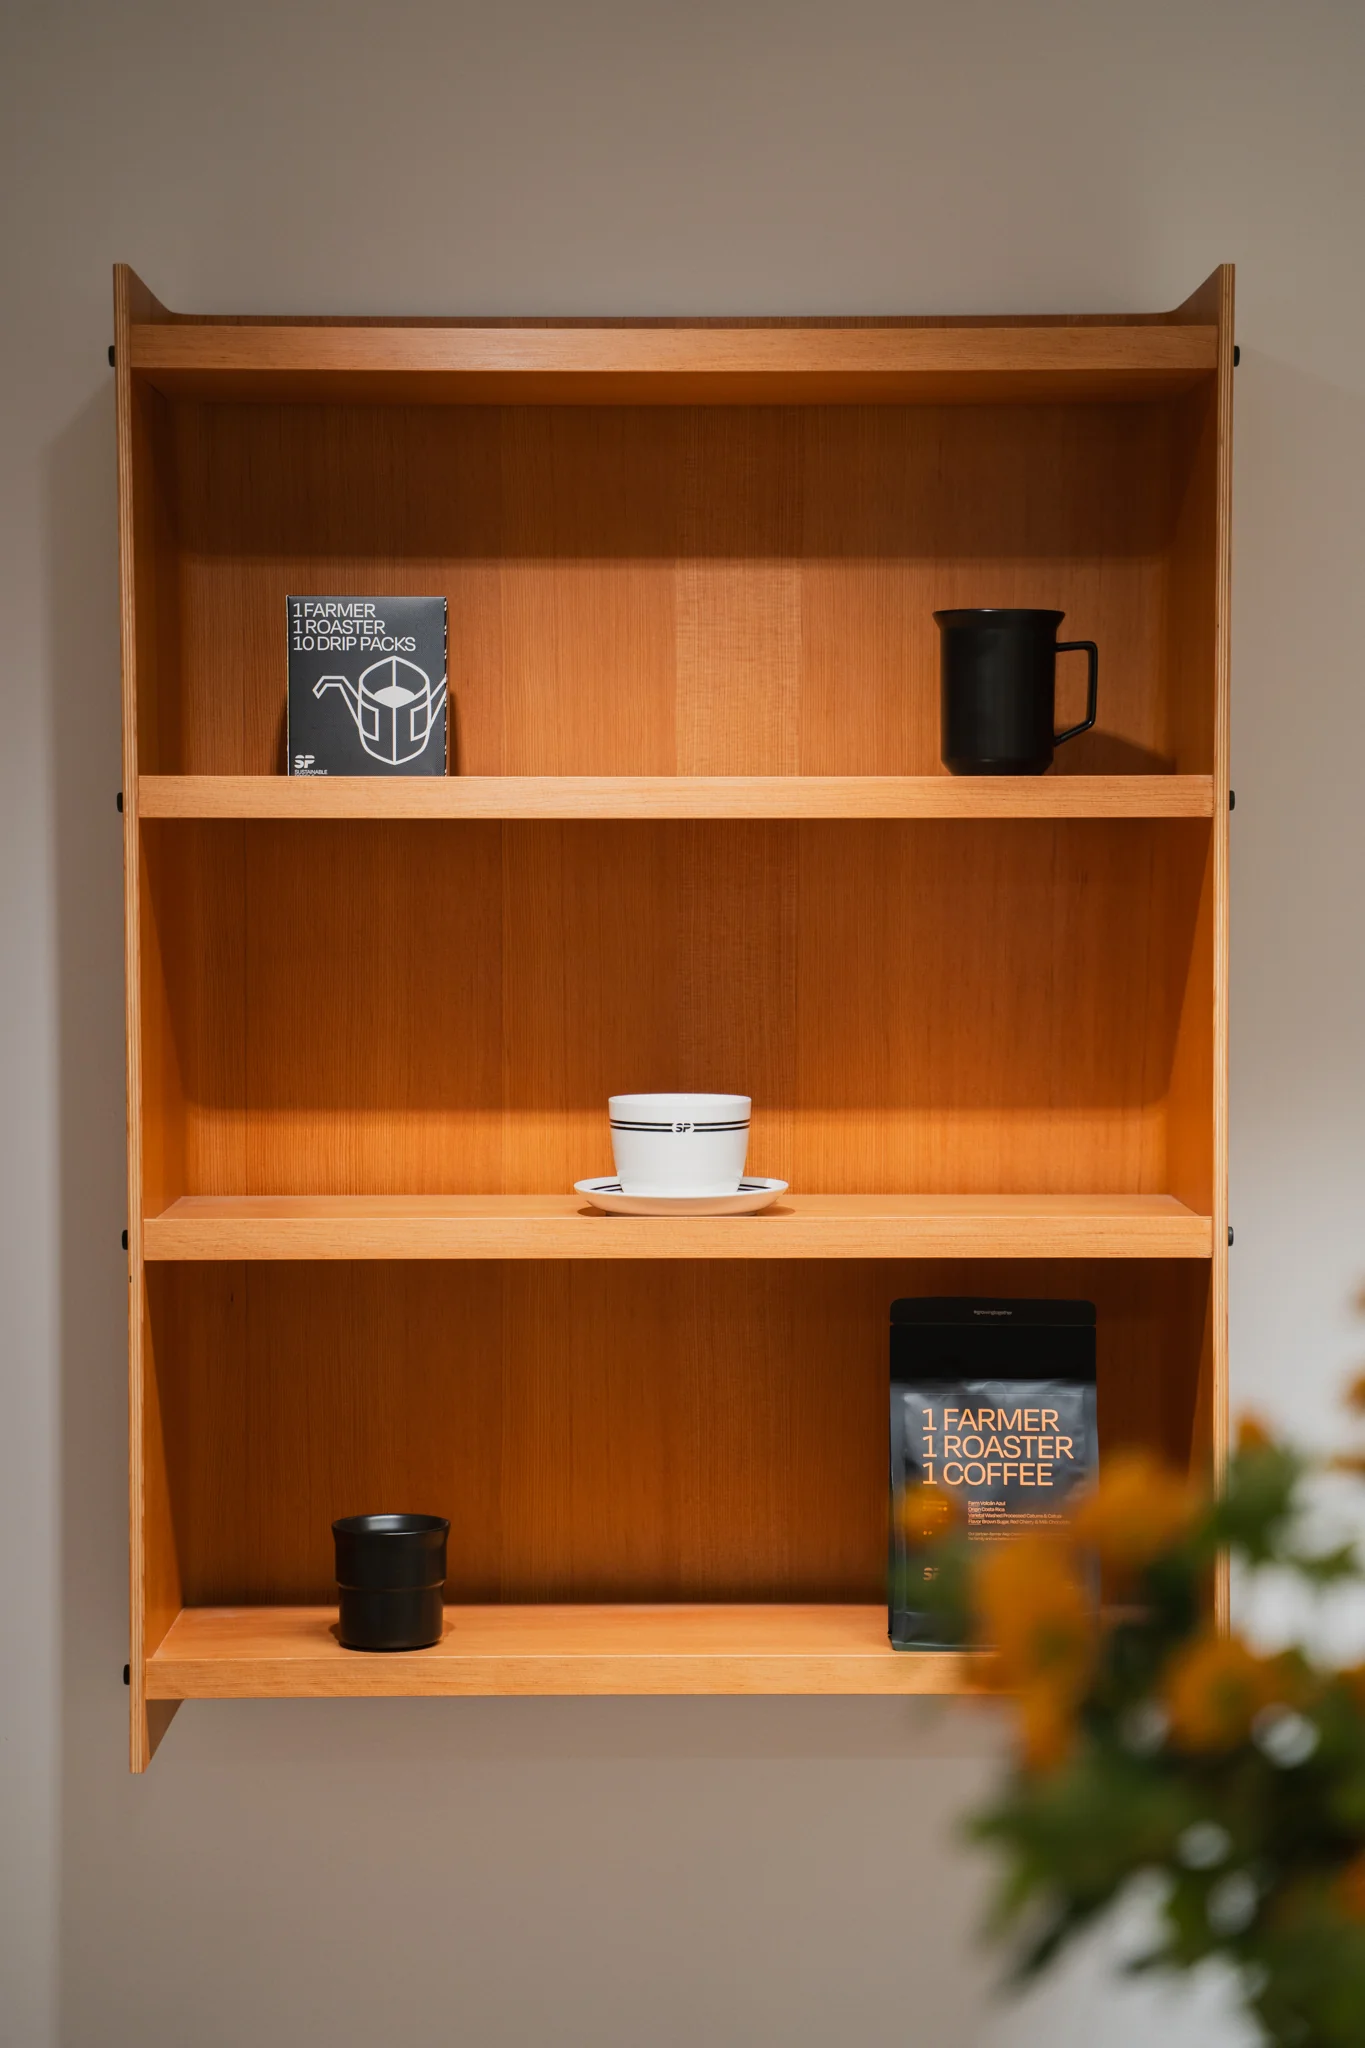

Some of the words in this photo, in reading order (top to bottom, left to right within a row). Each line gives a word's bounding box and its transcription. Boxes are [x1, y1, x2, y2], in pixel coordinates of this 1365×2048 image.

[293, 603, 303, 618] 1
[304, 603, 376, 618] FARMER
[293, 620, 303, 634] 1
[305, 620, 386, 635] ROASTER
[293, 636, 315, 652] 10
[317, 636, 357, 651] DRIP
[360, 636, 416, 652] PACKS
[294, 754, 315, 769] SP
[675, 1123, 692, 1133] SP
[922, 1408, 937, 1432] 1
[943, 1408, 1060, 1432] FARMER
[922, 1435, 937, 1459] 1
[944, 1435, 1075, 1460] ROASTER
[922, 1462, 937, 1486] 1
[942, 1462, 1054, 1487] COFFEE
